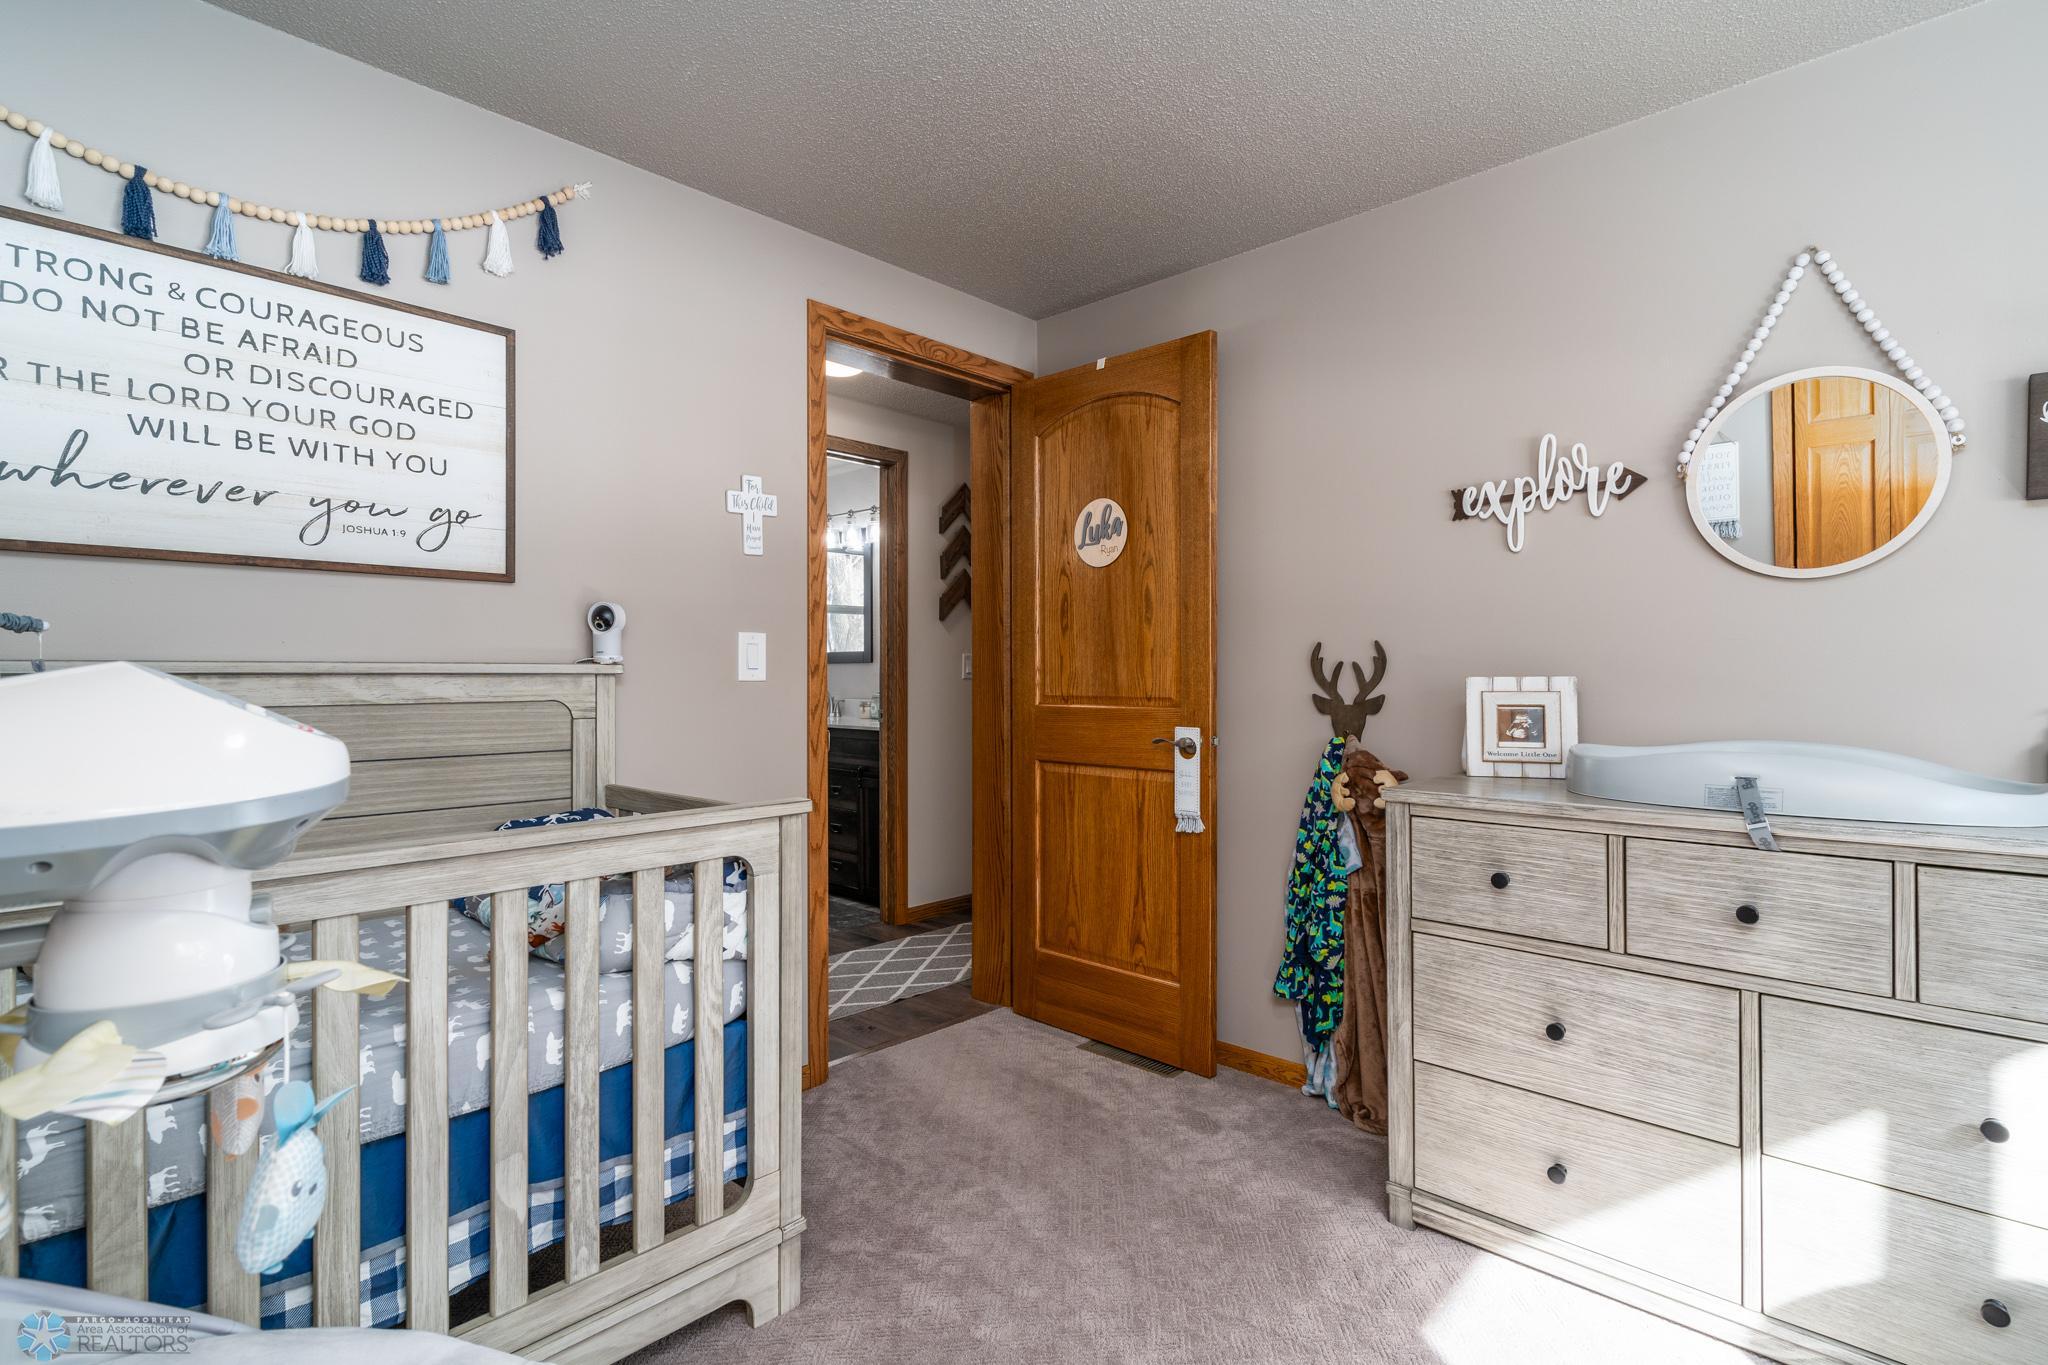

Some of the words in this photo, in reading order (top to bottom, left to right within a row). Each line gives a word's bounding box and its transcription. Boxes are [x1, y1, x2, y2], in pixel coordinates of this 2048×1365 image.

[0, 280, 63, 312] DO
[82, 296, 165, 332] NOT
[181, 317, 225, 345] BE
[237, 329, 358, 368] AFRAID
[5, 243, 153, 296] TRONG
[168, 282, 186, 302] &
[196, 287, 424, 353] COURAGEOUS
[27, 361, 111, 396] THE
[128, 378, 230, 412] LORD
[242, 397, 336, 431] YOUR
[350, 415, 416, 441] GOD
[184, 353, 235, 381] OR
[250, 364, 474, 420] DISCOURAGED
[127, 413, 220, 446] WILL
[235, 429, 276, 454] BE
[288, 436, 374, 467] WITH
[386, 451, 447, 476] YOU
[0, 429, 279, 506] wherever
[299, 497, 408, 546] you
[416, 507, 482, 552] go
[1462, 433, 1632, 553] explore
[342, 524, 389, 537] JOSHUA
[392, 529, 407, 538] 1:9
[1100, 544, 1119, 557] Ryan
[1487, 750, 1519, 758] Welcome
